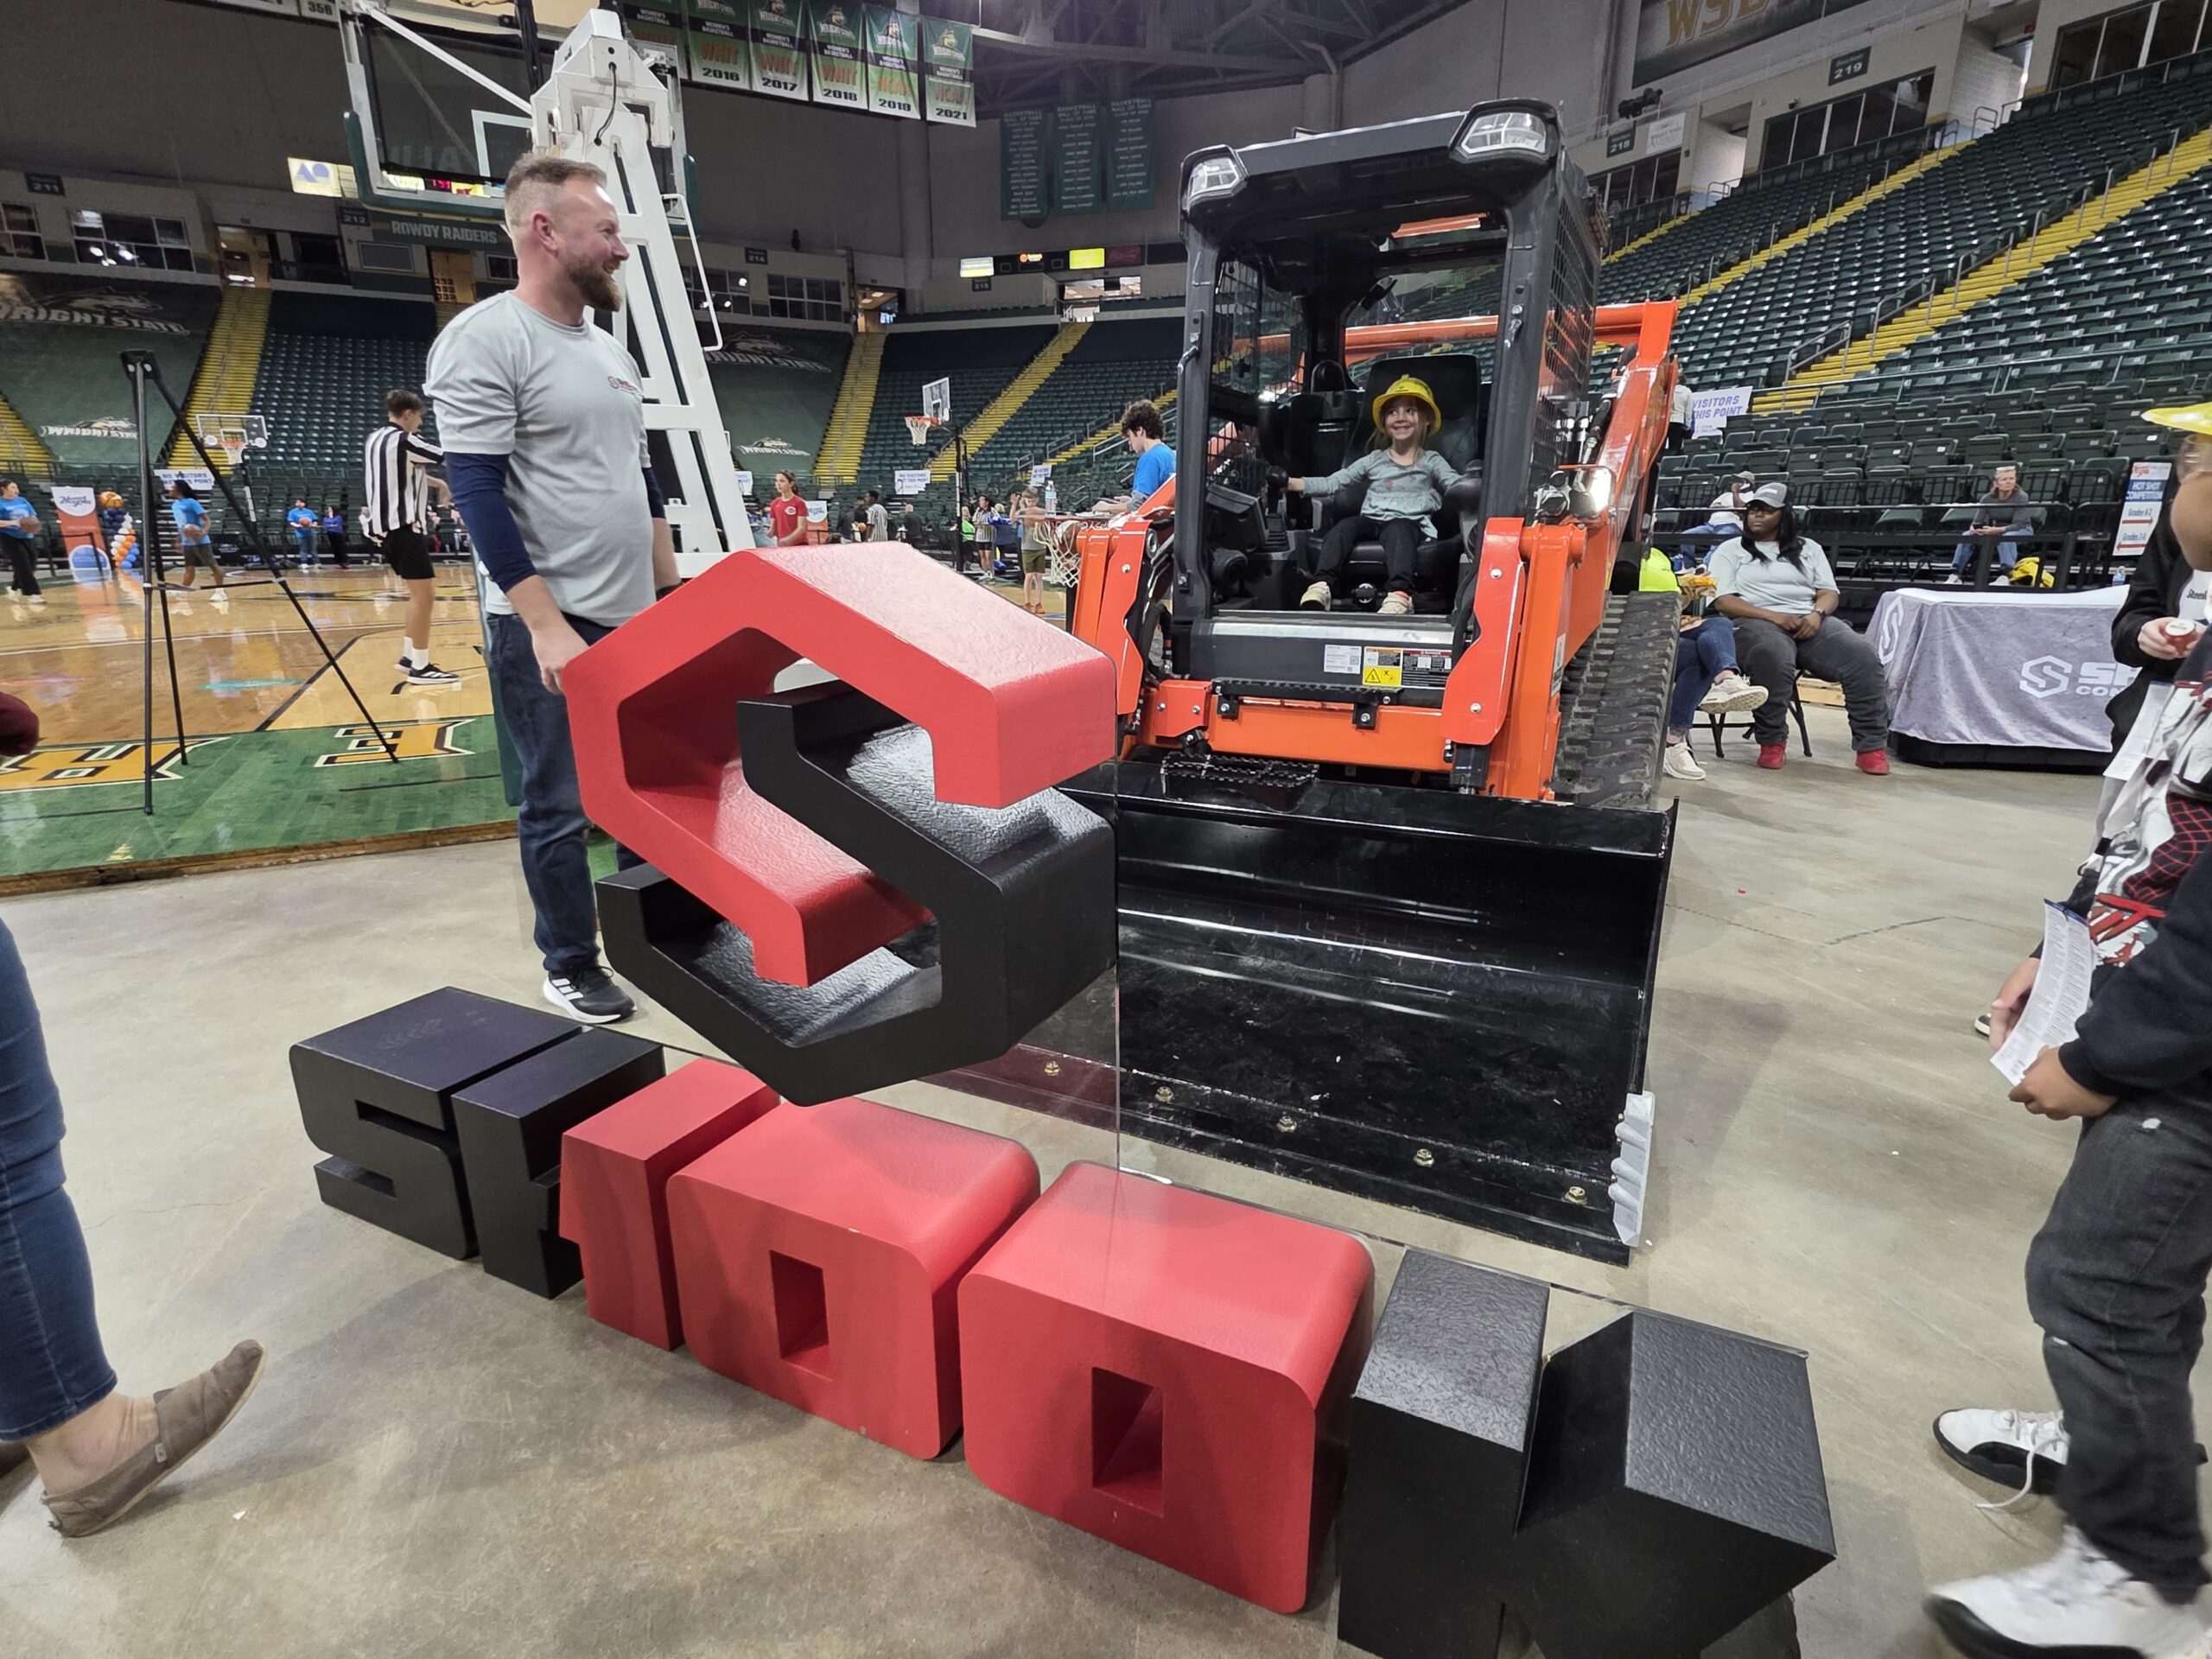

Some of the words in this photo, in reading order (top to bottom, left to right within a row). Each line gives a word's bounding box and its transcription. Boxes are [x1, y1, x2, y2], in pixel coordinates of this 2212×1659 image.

[702, 26, 734, 37] BASKETBALL
[762, 37, 794, 49] BASKETBALL
[701, 41, 738, 65] WNIT
[823, 49, 854, 60] BASKETBALL
[702, 67, 741, 81] 2016
[822, 64, 857, 86] WNIT
[1834, 62, 1862, 79] 219
[762, 78, 798, 92] 2017
[823, 88, 857, 102] 2018
[879, 99, 911, 112] 2019
[936, 108, 968, 120] 2021
[1610, 140, 1630, 153] 218
[33, 182, 60, 193] 211
[343, 215, 367, 224] 212
[391, 220, 441, 238] ROWDY
[442, 226, 499, 244] RAIDERS
[111, 316, 190, 335] STATE
[1692, 396, 1740, 409] VISITORS
[1713, 406, 1743, 418] POINT
[2132, 481, 2145, 491] HOT
[2145, 481, 2162, 491] SHOT
[2128, 508, 2144, 517] Grades
[2122, 532, 2138, 541] Grades
